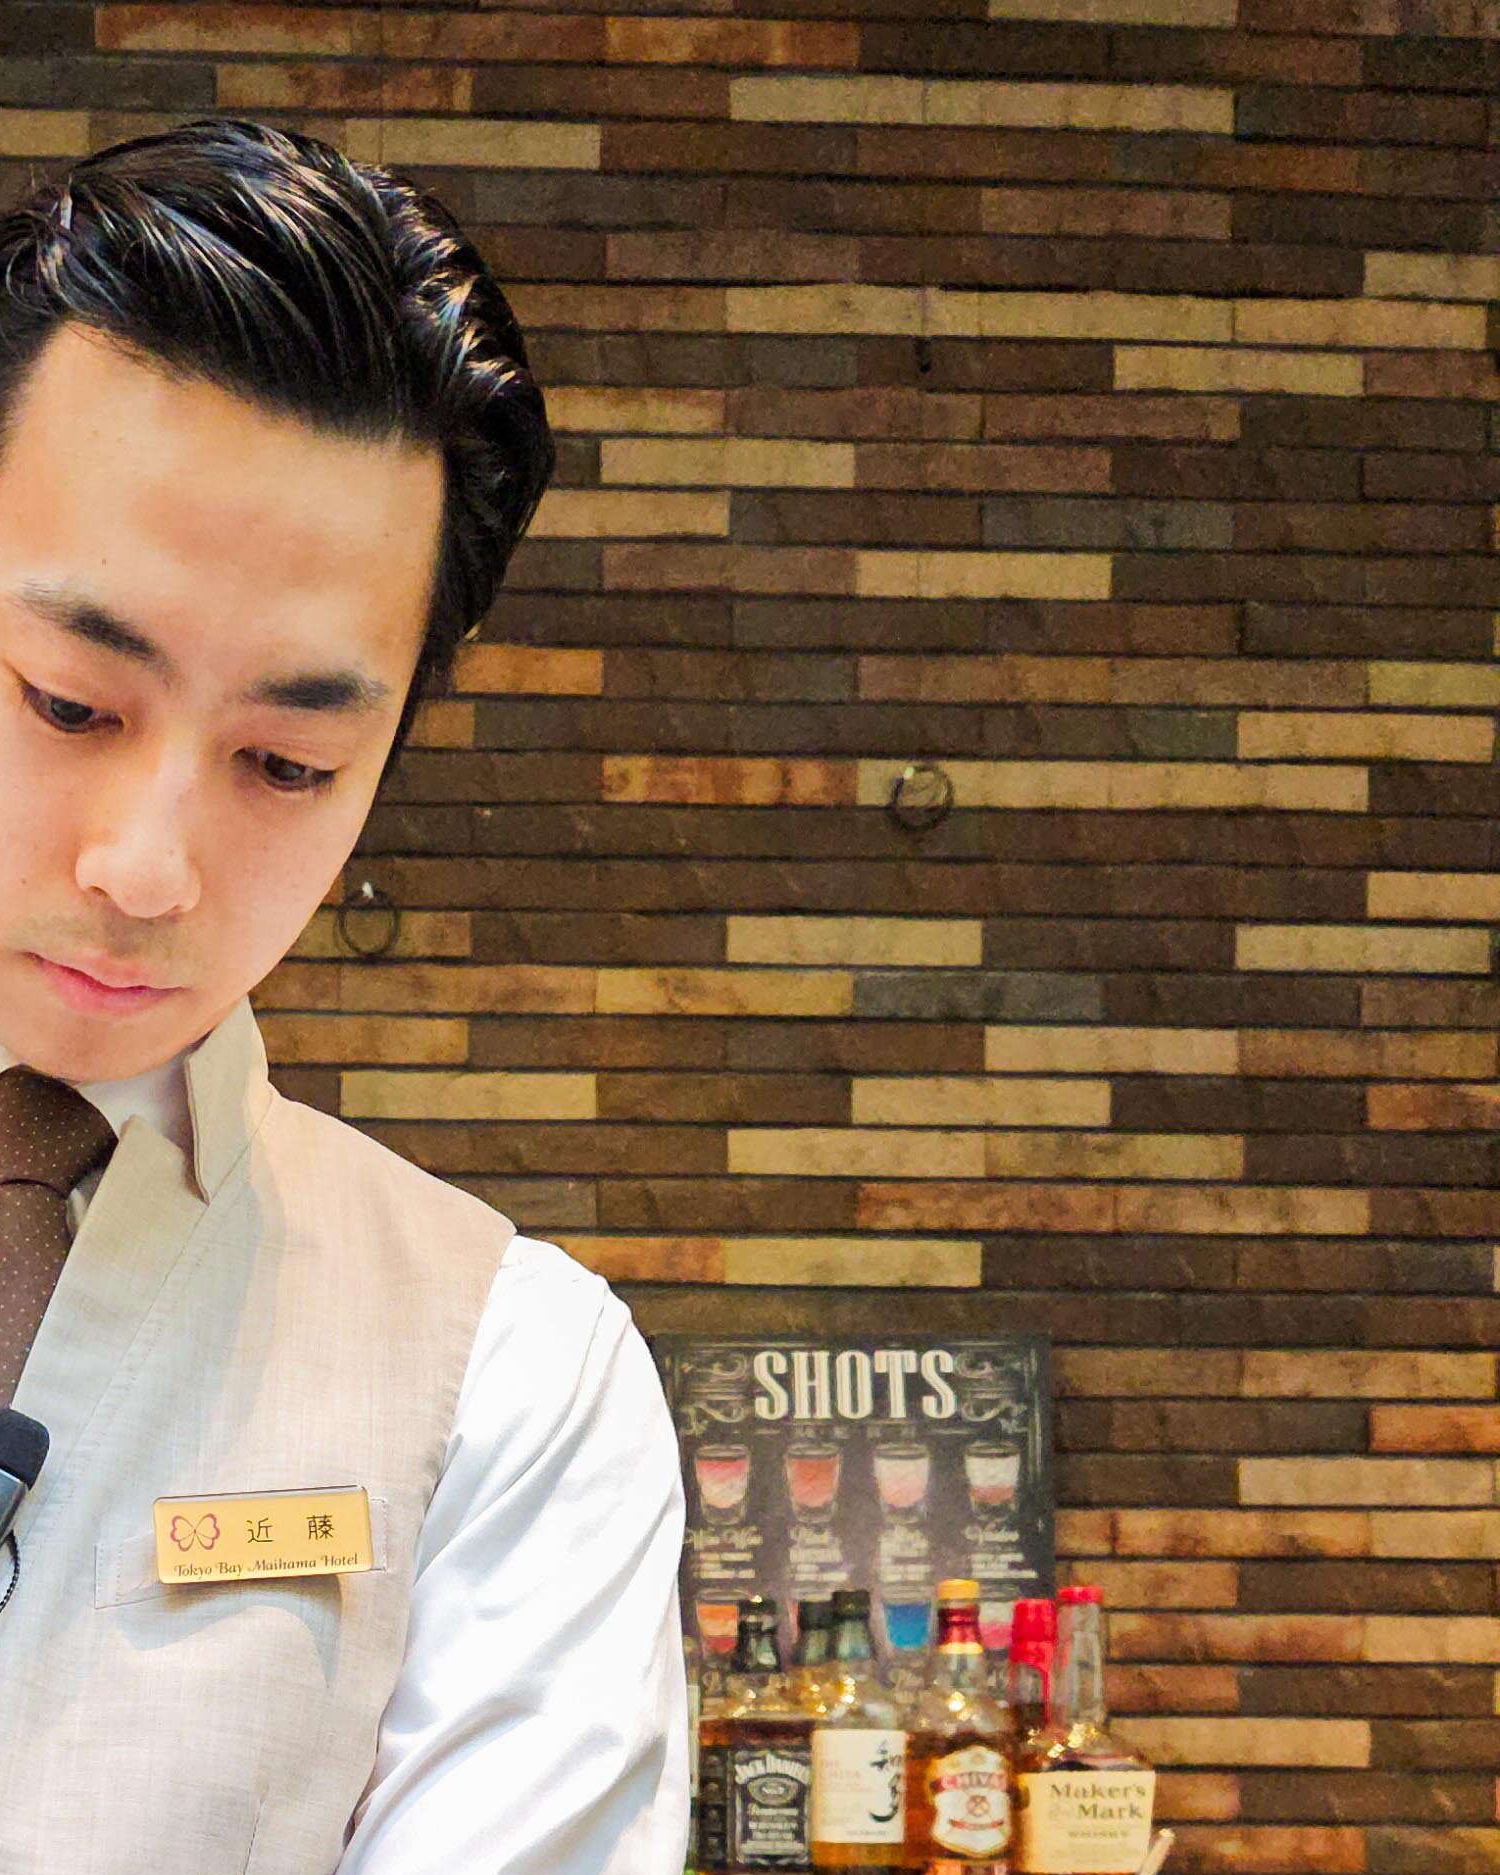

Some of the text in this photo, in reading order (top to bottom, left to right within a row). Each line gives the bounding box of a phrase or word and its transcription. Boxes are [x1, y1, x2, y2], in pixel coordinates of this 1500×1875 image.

[753, 1350, 957, 1420] SHOTS
[174, 1553, 357, 1579] Tokyo Bay Maihama Hotel
[1049, 1783, 1145, 1799] Maker's
[1078, 1803, 1143, 1819] Mark
